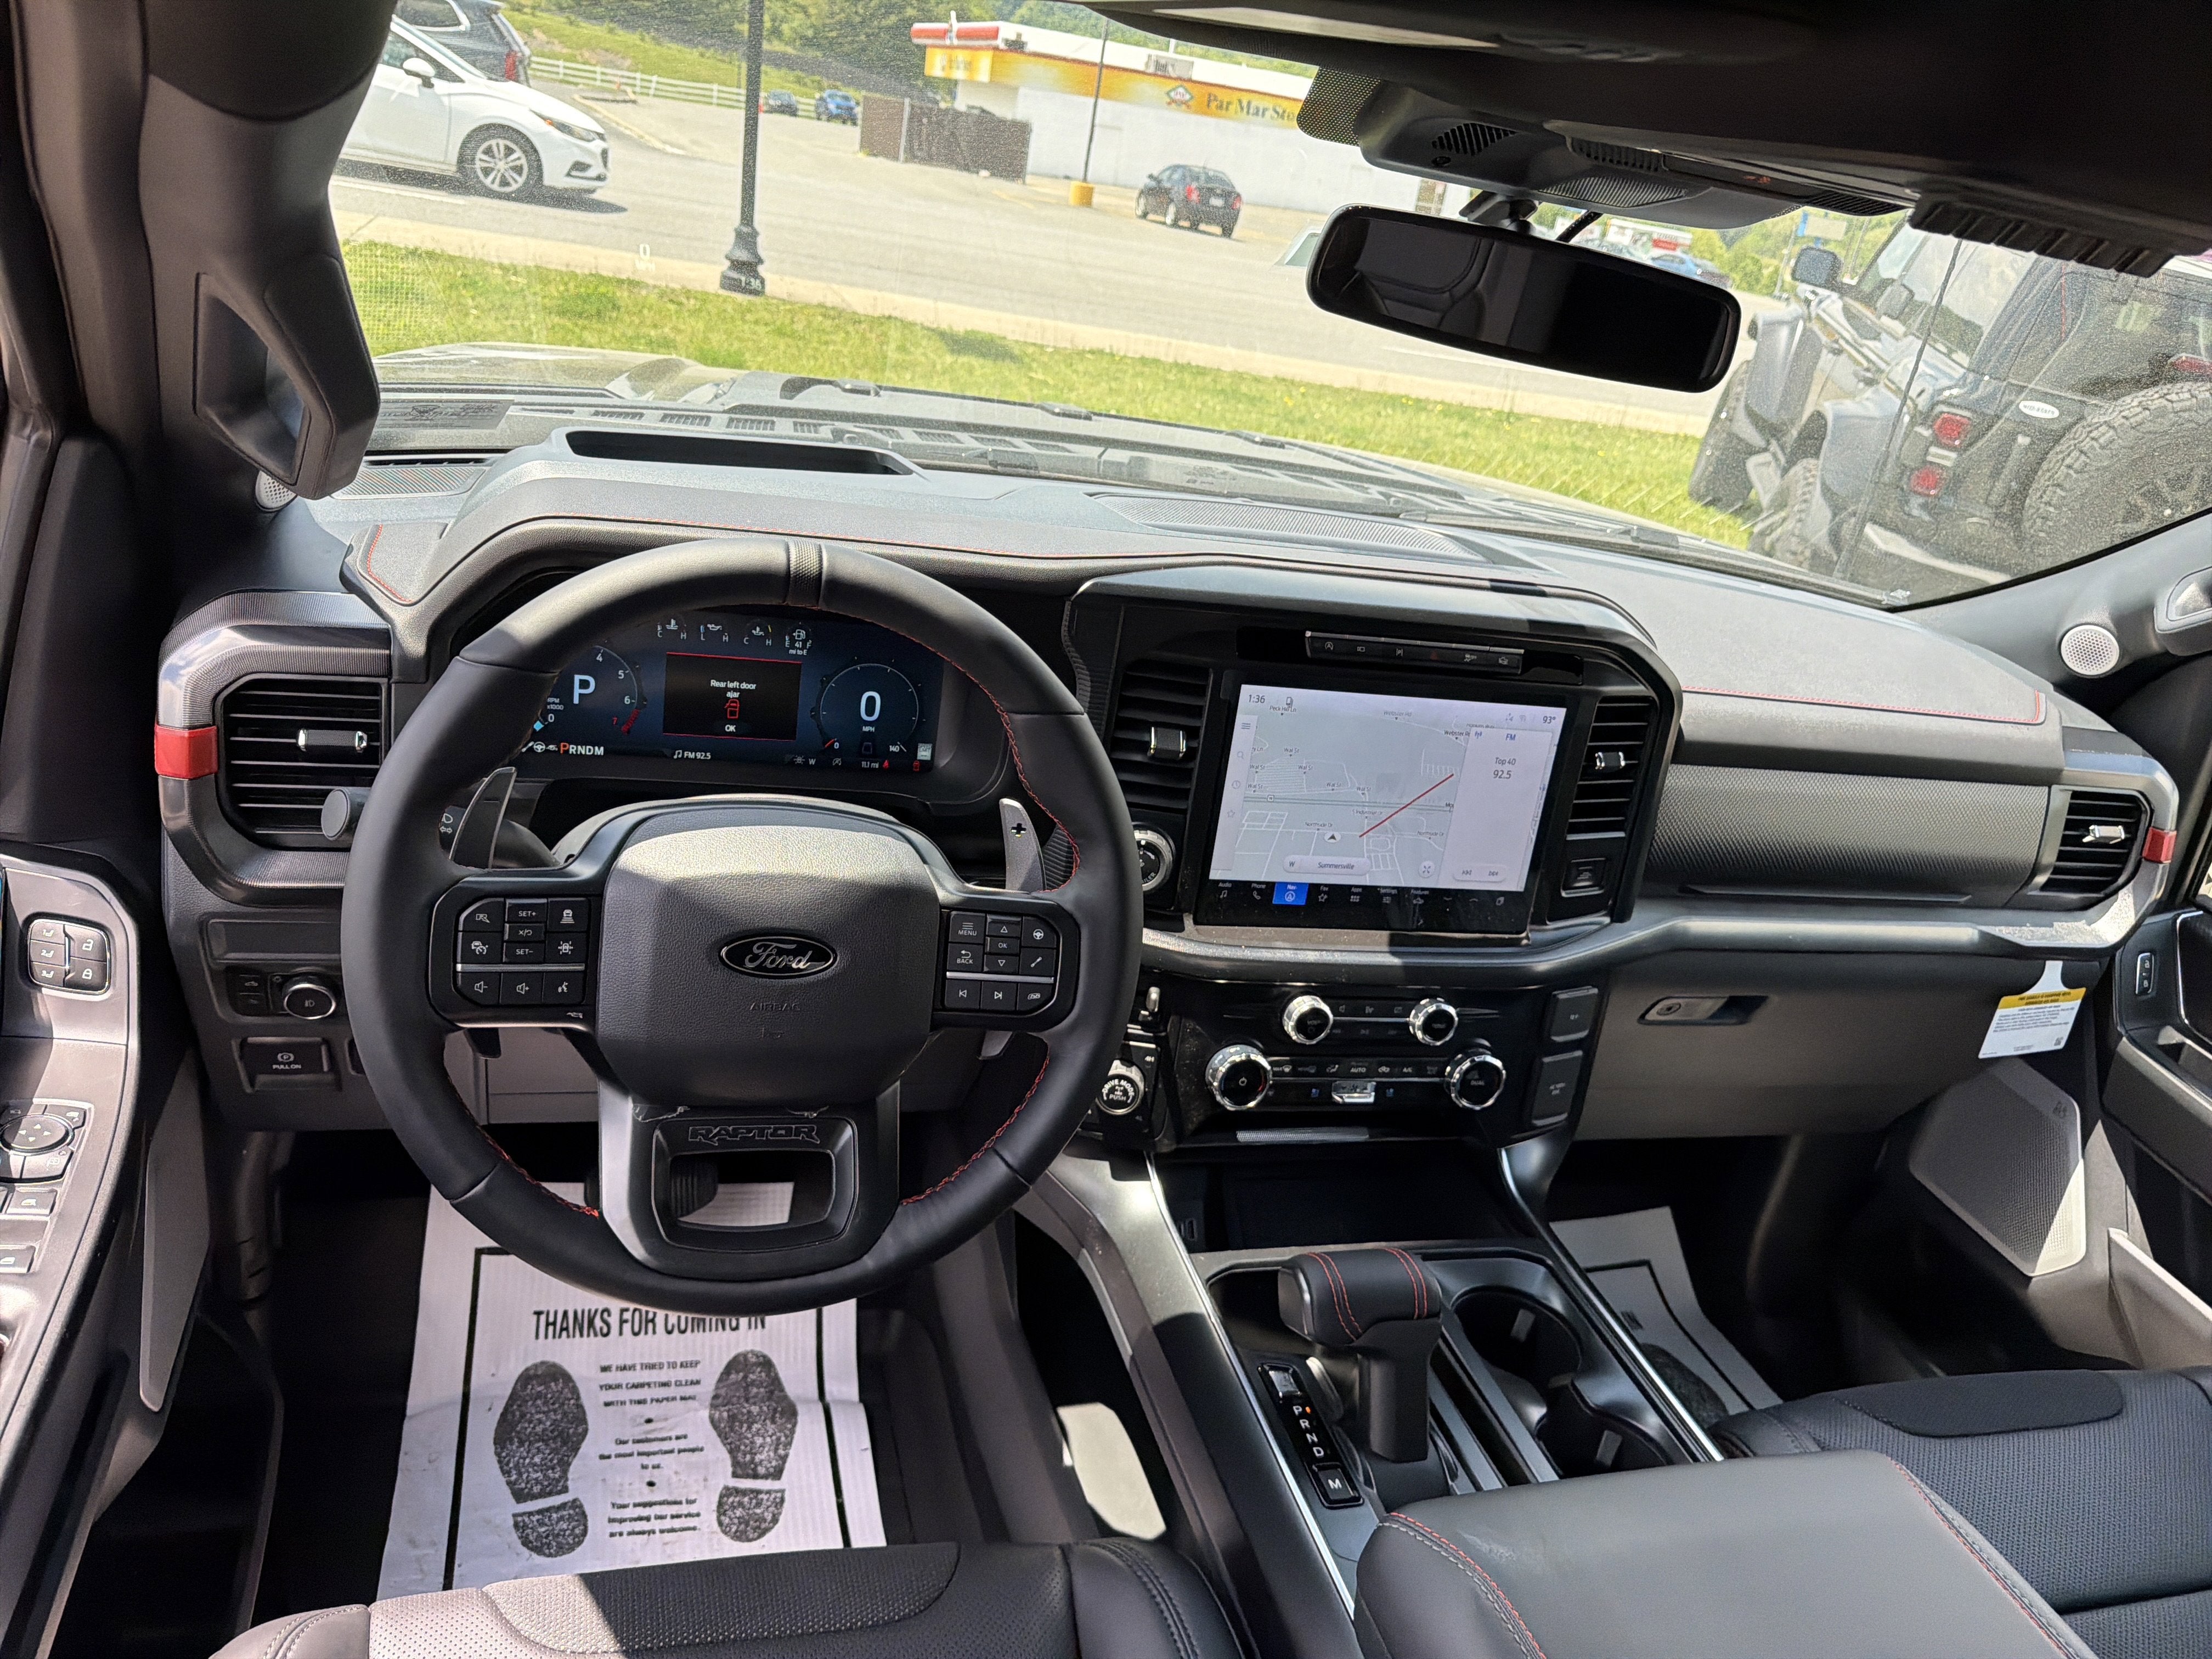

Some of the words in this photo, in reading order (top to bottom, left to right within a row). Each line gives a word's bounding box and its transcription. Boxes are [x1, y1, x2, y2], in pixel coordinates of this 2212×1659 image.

[1207, 93, 1232, 111] Par
[1235, 98, 1268, 119] Mar
[1270, 104, 1297, 122] Sto
[723, 634, 729, 642] H
[596, 653, 602, 662] 4
[618, 670, 624, 679] 5
[573, 674, 595, 704] P
[710, 679, 726, 687] Rear
[727, 680, 740, 689] left
[741, 681, 757, 690] door
[624, 696, 630, 705] 6
[1249, 695, 1265, 703] 1:36
[860, 691, 881, 721] 0
[548, 714, 555, 723] 0
[612, 716, 618, 725] 7
[1543, 715, 1556, 724] 93°
[725, 724, 736, 732] OK
[1495, 757, 1506, 765] Top
[1493, 770, 1511, 779] 92.5
[1318, 862, 1354, 870] Summersville
[744, 941, 815, 969] Ford
[1102, 1079, 1119, 1094] DRIVE
[1120, 1079, 1135, 1096] MODE
[689, 1125, 820, 1146] RAPTOR
[533, 1307, 612, 1340] THANKS
[619, 1307, 657, 1336] FOR
[600, 1364, 613, 1373] WE
[615, 1363, 637, 1372] HAVE
[640, 1362, 665, 1370] TRIED
[666, 1361, 678, 1369] TO
[679, 1359, 701, 1368] KEEP
[599, 1382, 623, 1391] YOUR
[625, 1380, 672, 1390] CARPETING
[674, 1378, 702, 1387] CLEAN
[650, 1396, 677, 1404] PAPER
[1293, 1405, 1302, 1416] P
[1299, 1419, 1310, 1429] R
[614, 1437, 629, 1446] Our
[632, 1435, 673, 1444] customers
[1306, 1432, 1318, 1443] N
[614, 1451, 635, 1459] most
[637, 1448, 675, 1457] important
[678, 1445, 705, 1455] people
[1313, 1447, 1324, 1458] D
[1328, 1478, 1342, 1489] M
[610, 1501, 630, 1509] Your
[633, 1498, 683, 1509] suggestions
[607, 1514, 651, 1524] improving
[670, 1511, 701, 1520] service
[627, 1528, 657, 1537] always
[659, 1525, 701, 1534] welcome.
